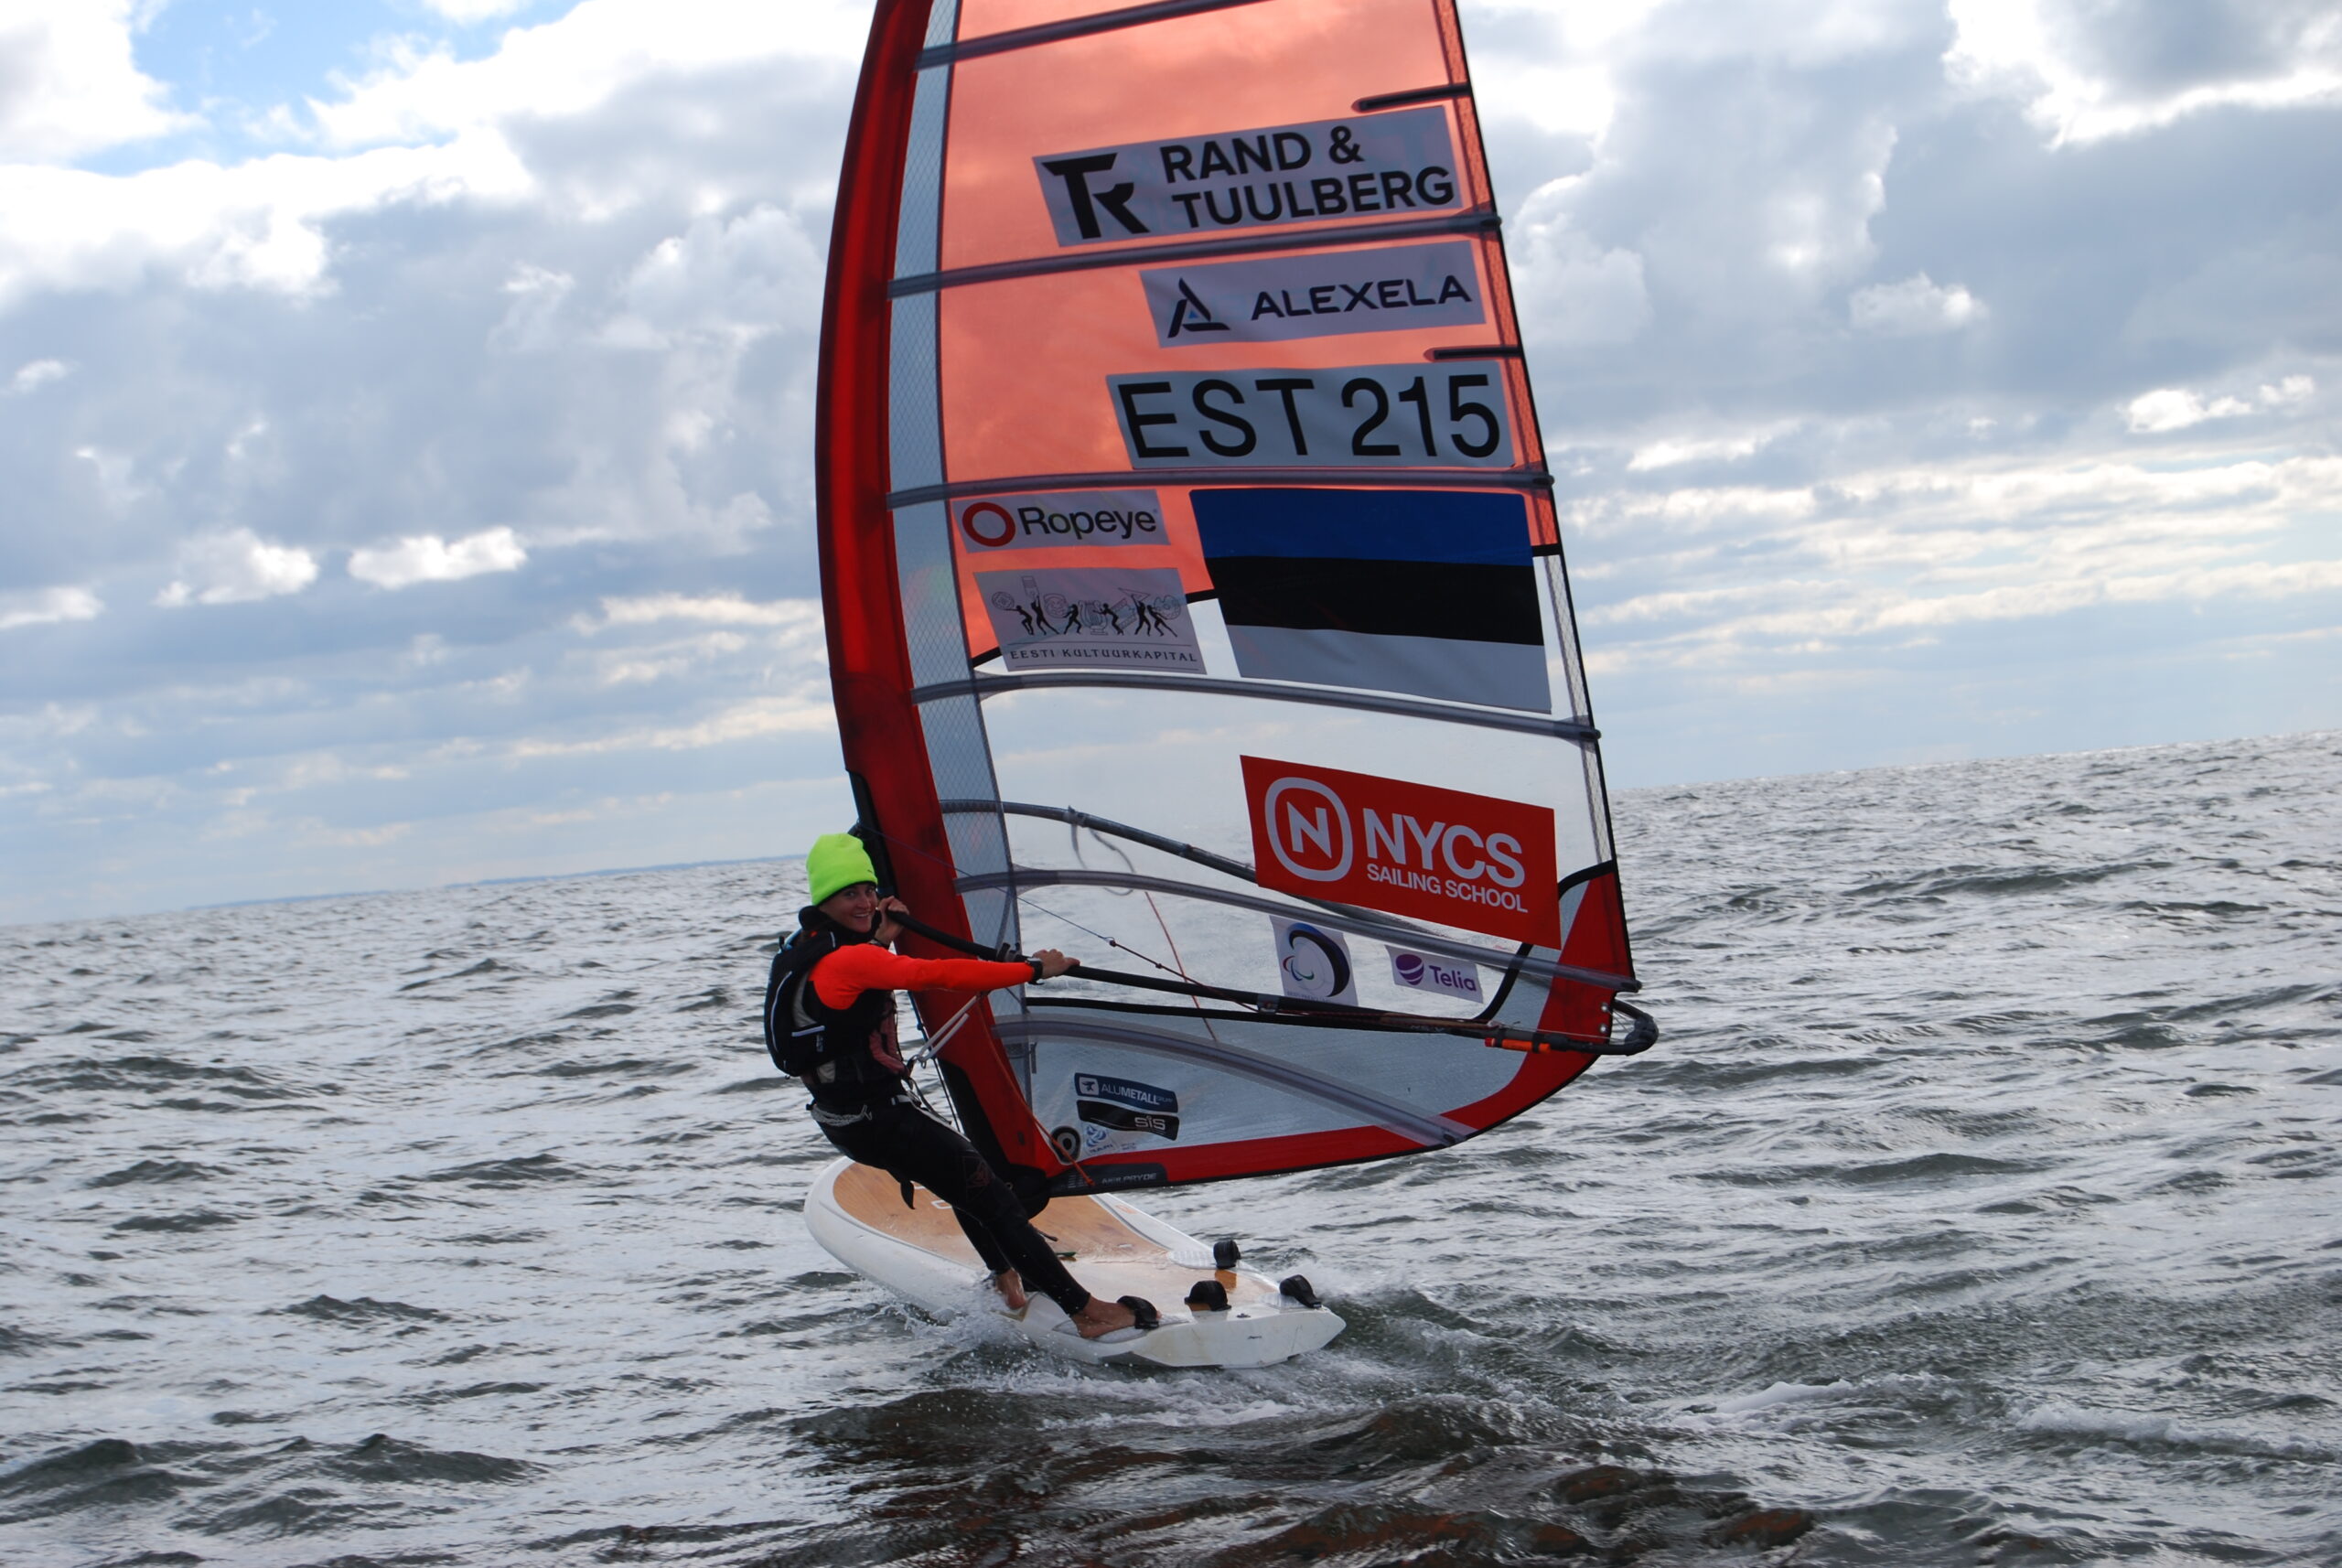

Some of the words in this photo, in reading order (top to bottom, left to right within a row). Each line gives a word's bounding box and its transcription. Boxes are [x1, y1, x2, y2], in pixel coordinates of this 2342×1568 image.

[1159, 132, 1312, 184] RAND
[1328, 125, 1364, 166] &
[1172, 166, 1455, 229] TUULBERG
[1251, 274, 1473, 321] ALEXELA
[1117, 376, 1316, 459] EST
[1341, 374, 1501, 459] 215
[1017, 506, 1157, 541] Ropeye
[1010, 649, 1055, 660] EESTI
[1061, 648, 1198, 663] KULTUURKAPITAL
[1363, 807, 1526, 889] NYCS
[1367, 863, 1442, 896] SAILING
[1445, 879, 1529, 914] SCHOOL
[1429, 964, 1477, 993] Telia
[1101, 1083, 1160, 1105] ALUMETALL
